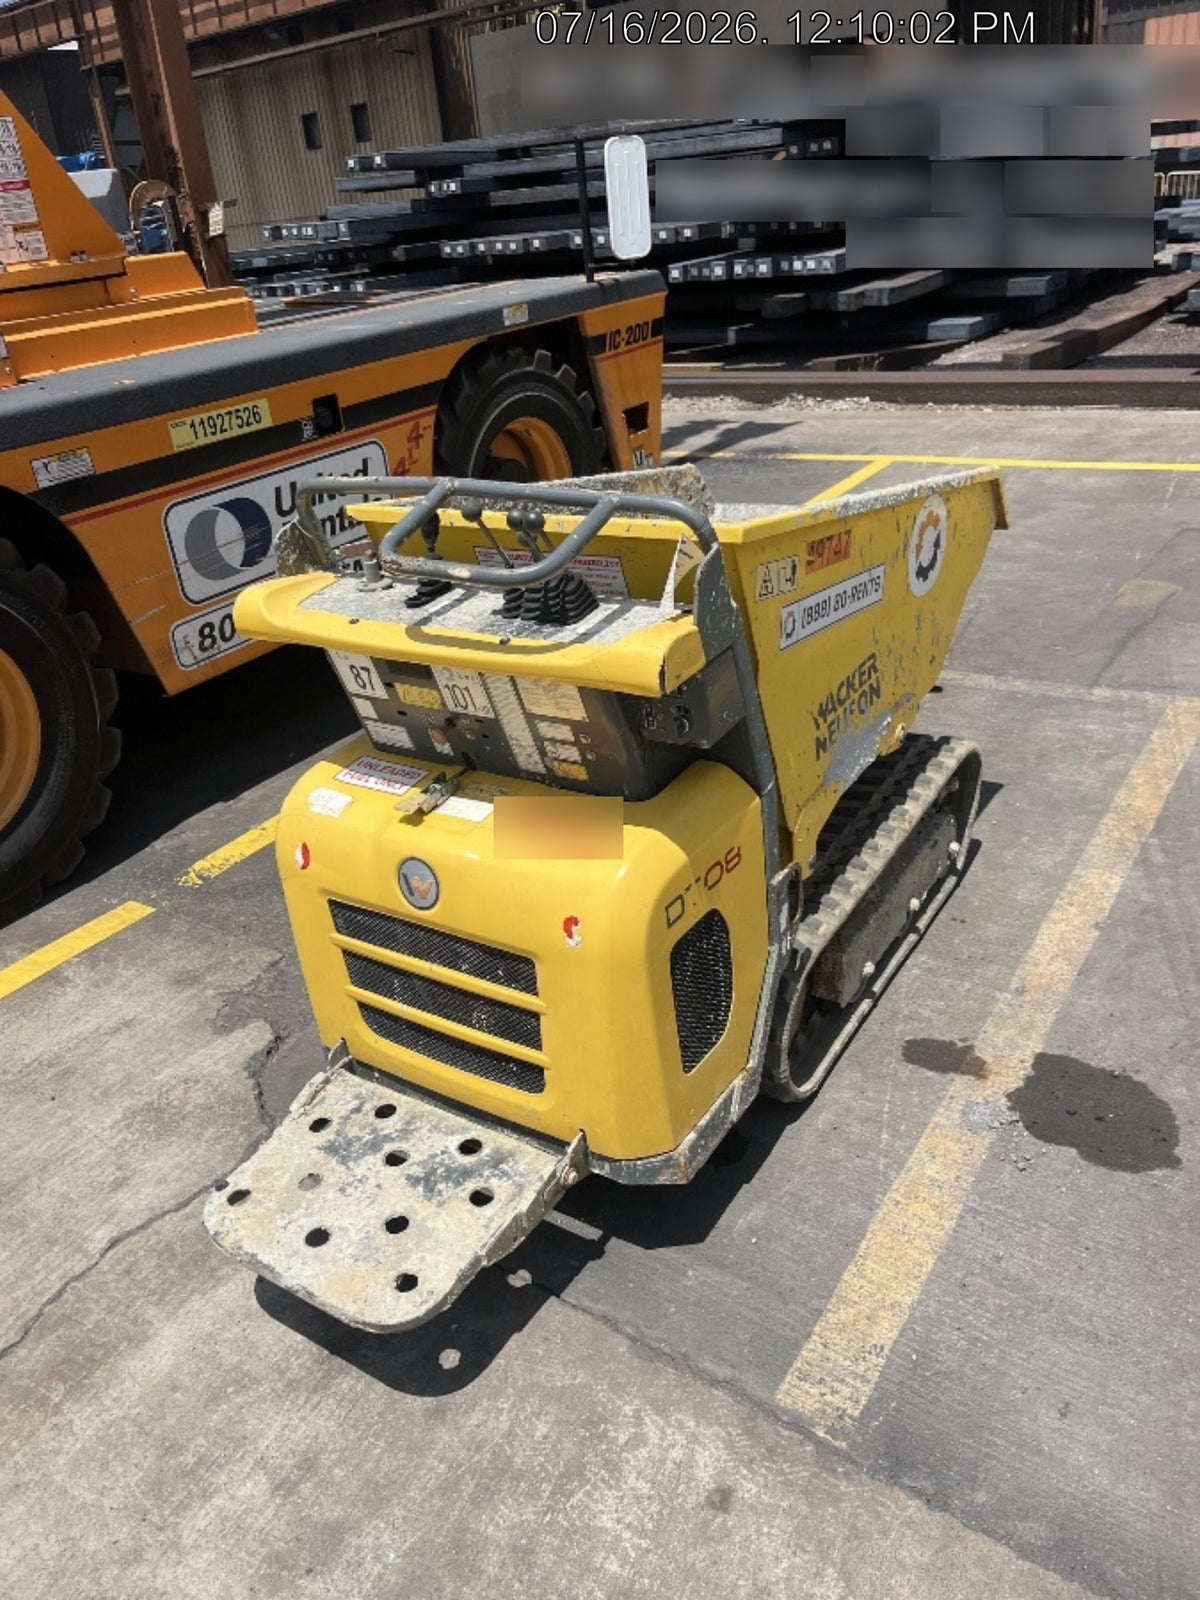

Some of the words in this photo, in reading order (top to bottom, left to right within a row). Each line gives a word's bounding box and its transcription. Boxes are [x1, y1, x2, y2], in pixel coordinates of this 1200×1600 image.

[607, 320, 650, 351] IC-200
[189, 404, 262, 440] 11927526
[349, 664, 375, 691] 87
[444, 684, 477, 711] 101
[356, 759, 421, 780] UNLEADED
